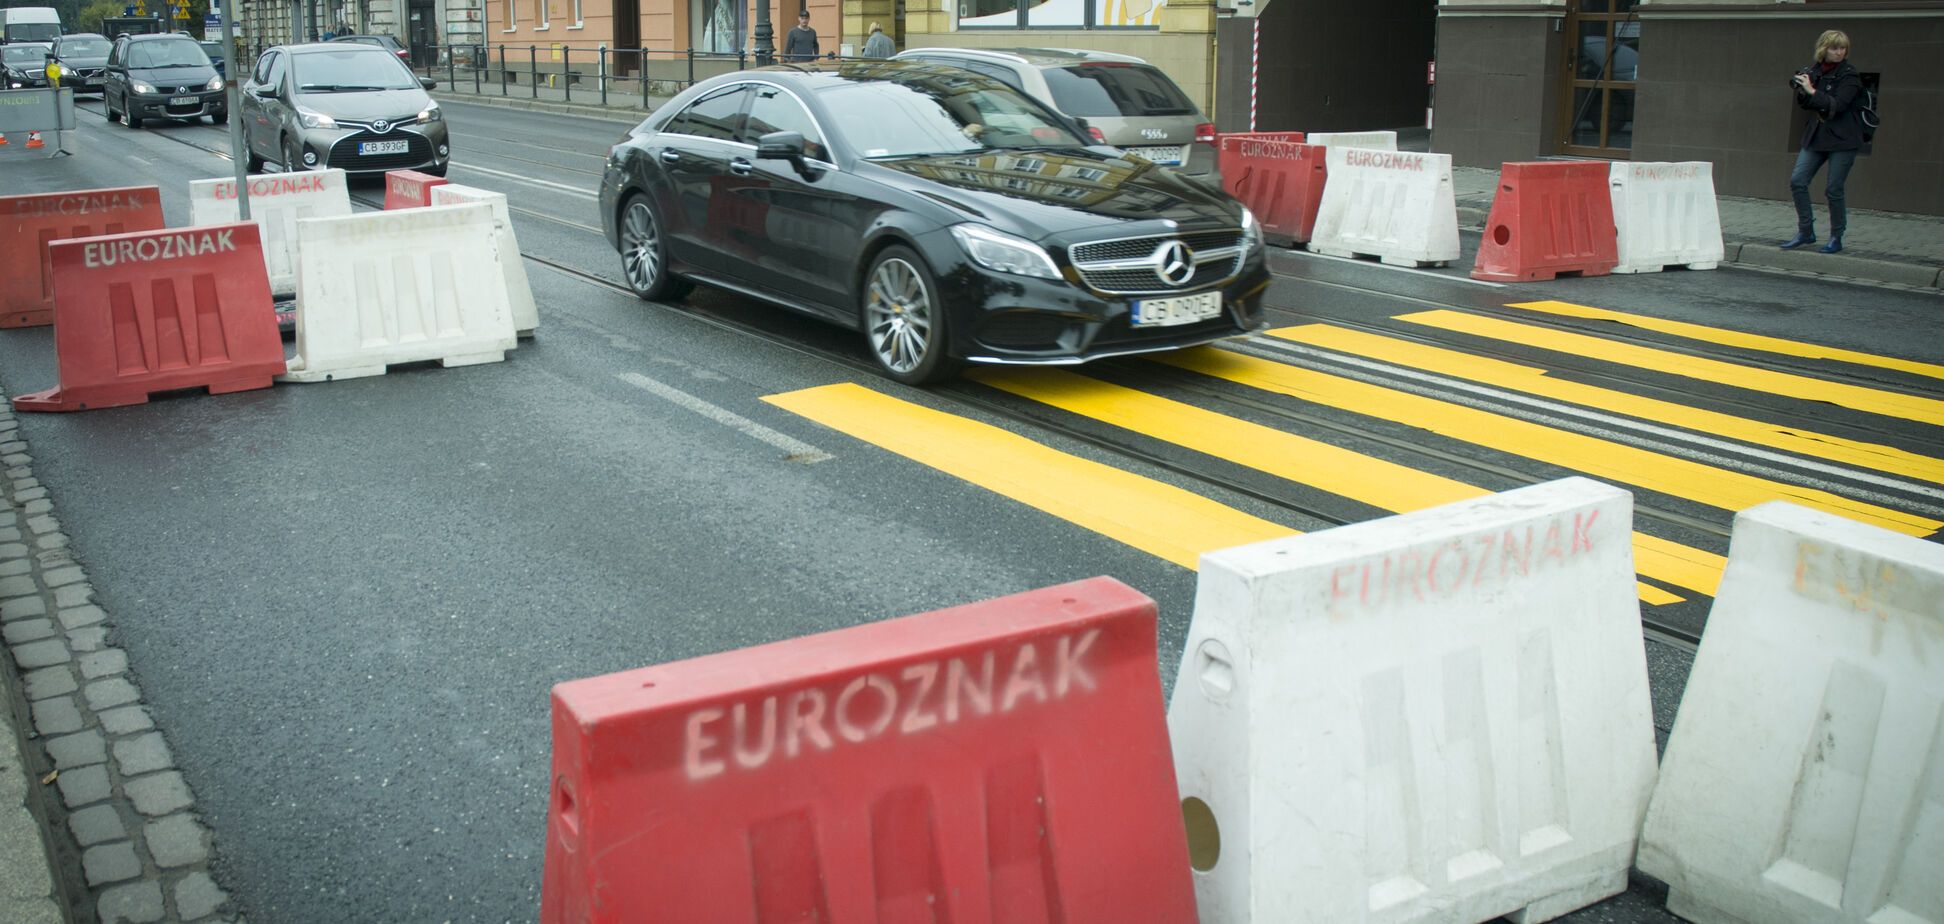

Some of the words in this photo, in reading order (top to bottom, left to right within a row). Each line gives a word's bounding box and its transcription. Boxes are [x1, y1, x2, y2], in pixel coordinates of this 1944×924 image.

[364, 143, 378, 152] CB
[380, 141, 407, 152] 393GF
[1240, 141, 1303, 160] EUROZNAK
[1346, 151, 1424, 171] EUROZNAK
[214, 176, 325, 200] EUOZNAK
[84, 228, 237, 268] EUROZNAK
[1143, 300, 1168, 320] CB
[1327, 509, 1600, 620] EUROZNAK
[683, 628, 1100, 780] EUROZNAK
